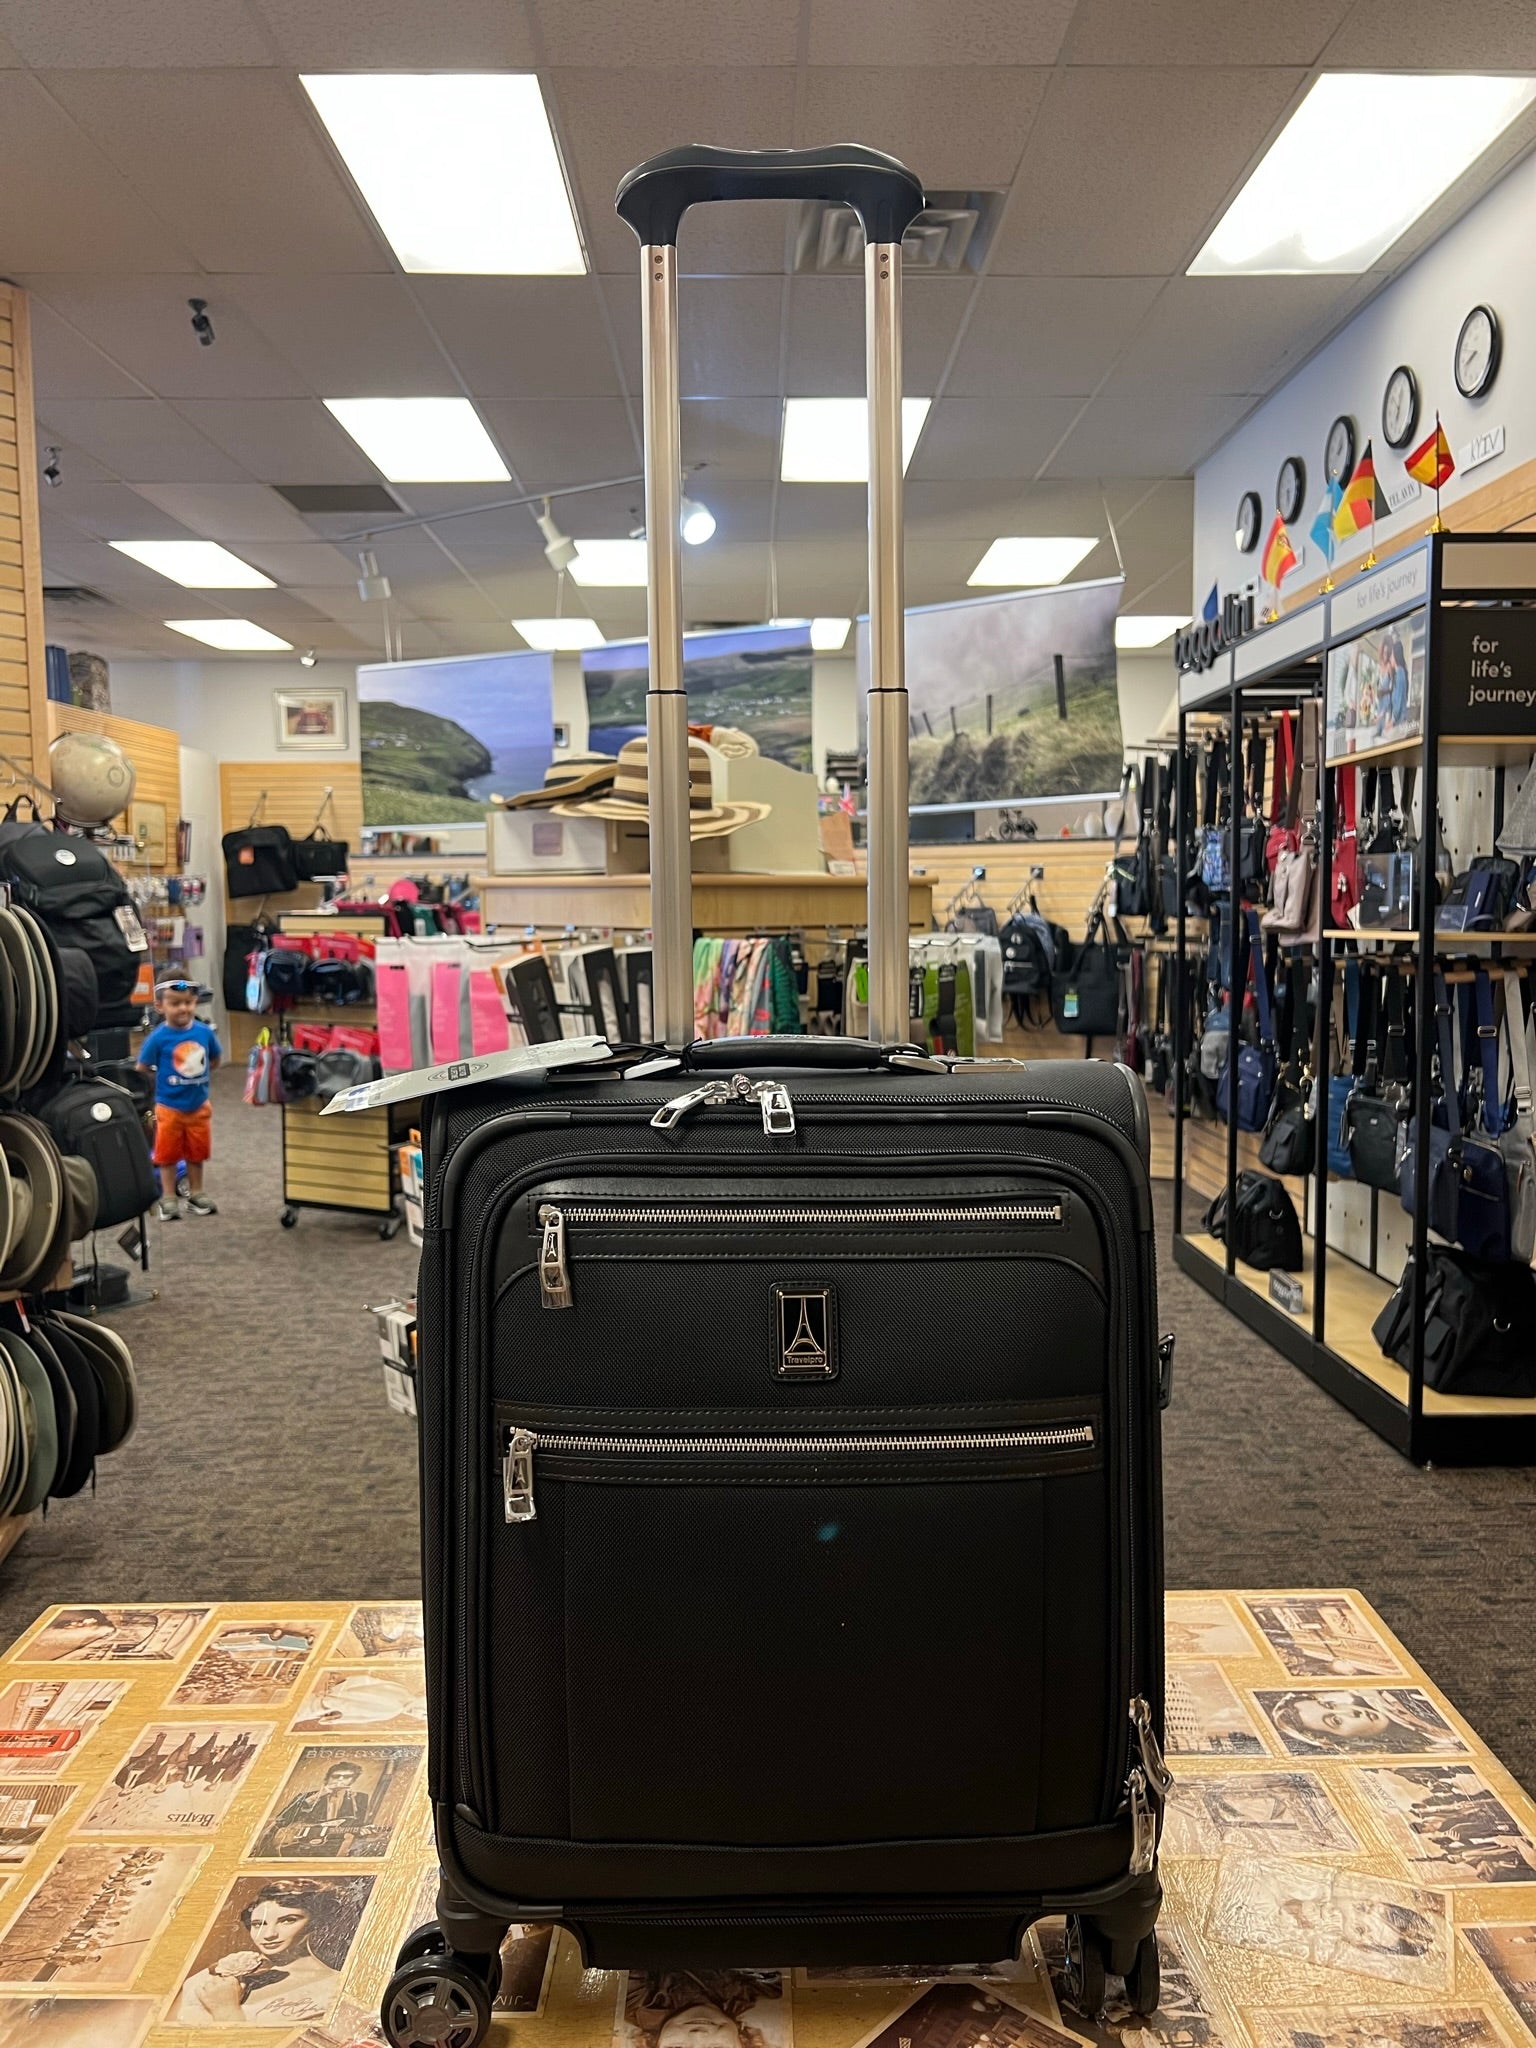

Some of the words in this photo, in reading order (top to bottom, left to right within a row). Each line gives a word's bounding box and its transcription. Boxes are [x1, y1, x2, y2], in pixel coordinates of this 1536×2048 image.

[1470, 428, 1500, 463] KYIV
[1356, 591, 1367, 609] for
[1387, 568, 1418, 600] journey
[1471, 634, 1499, 654] for
[1471, 659, 1512, 678] life's
[1467, 684, 1536, 708] journey
[786, 1355, 824, 1366] Travelpro
